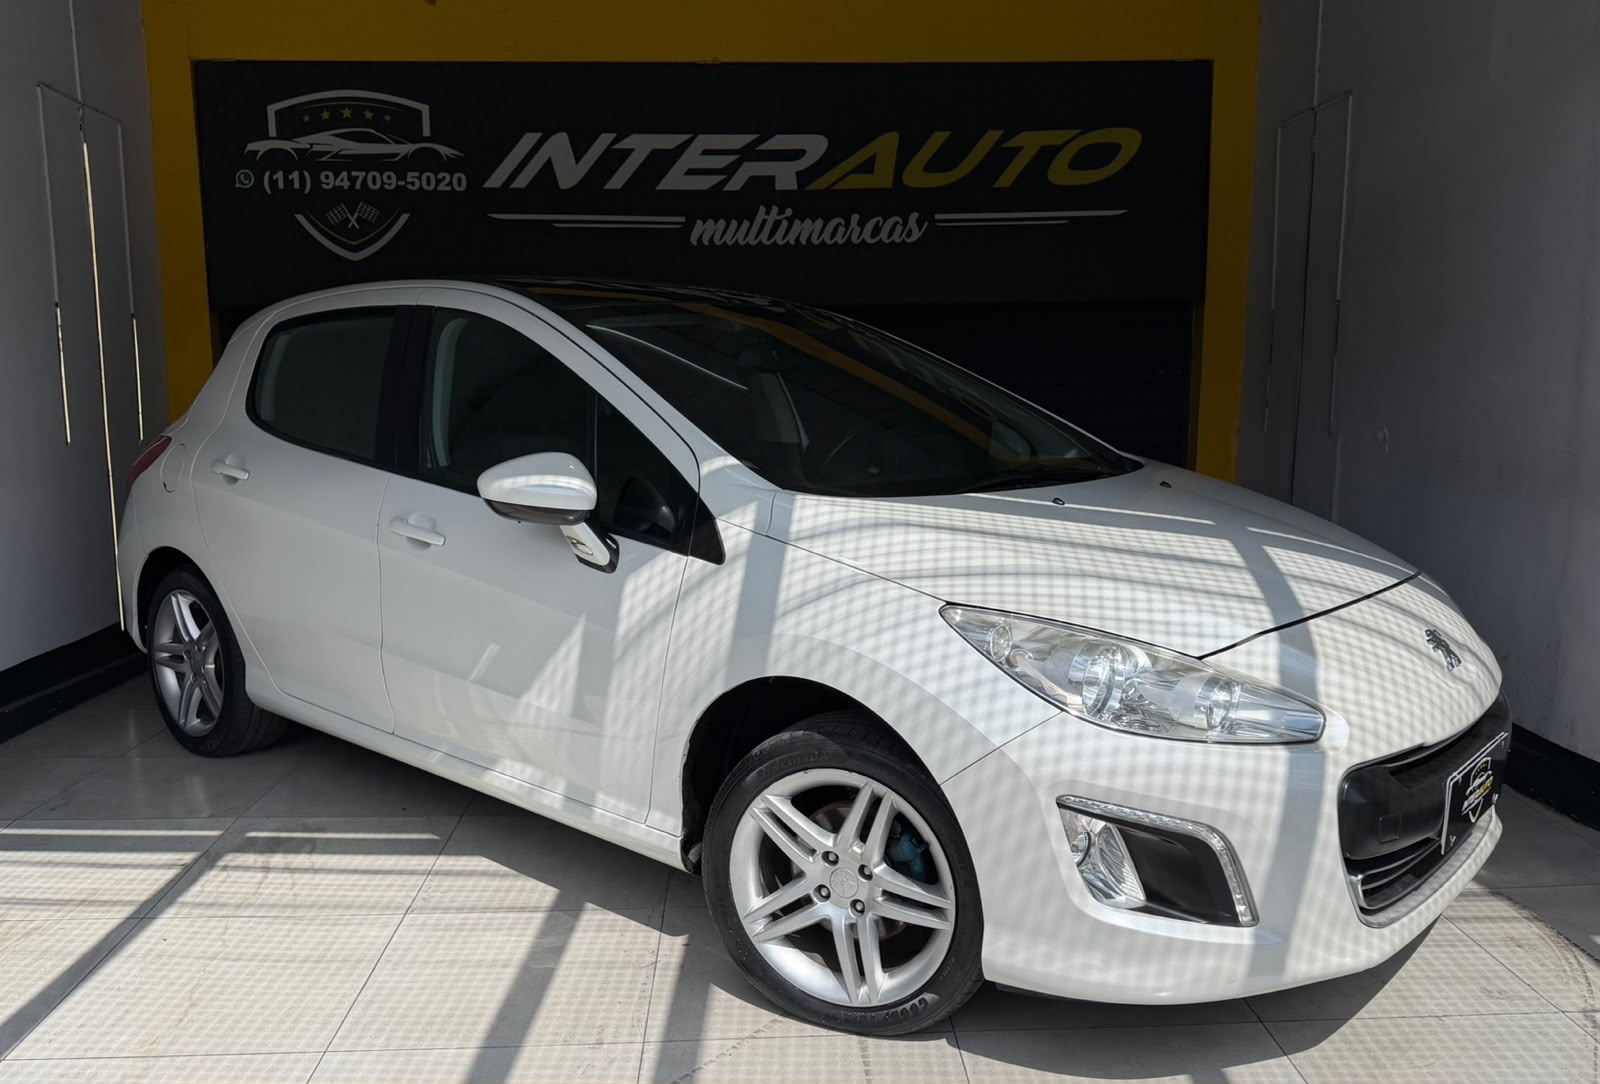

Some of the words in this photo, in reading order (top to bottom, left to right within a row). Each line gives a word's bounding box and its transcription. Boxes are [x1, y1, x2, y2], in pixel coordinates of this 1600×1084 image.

[263, 170, 312, 195] (11)
[319, 171, 468, 192] 94709-5020
[690, 205, 928, 246] multimarcas
